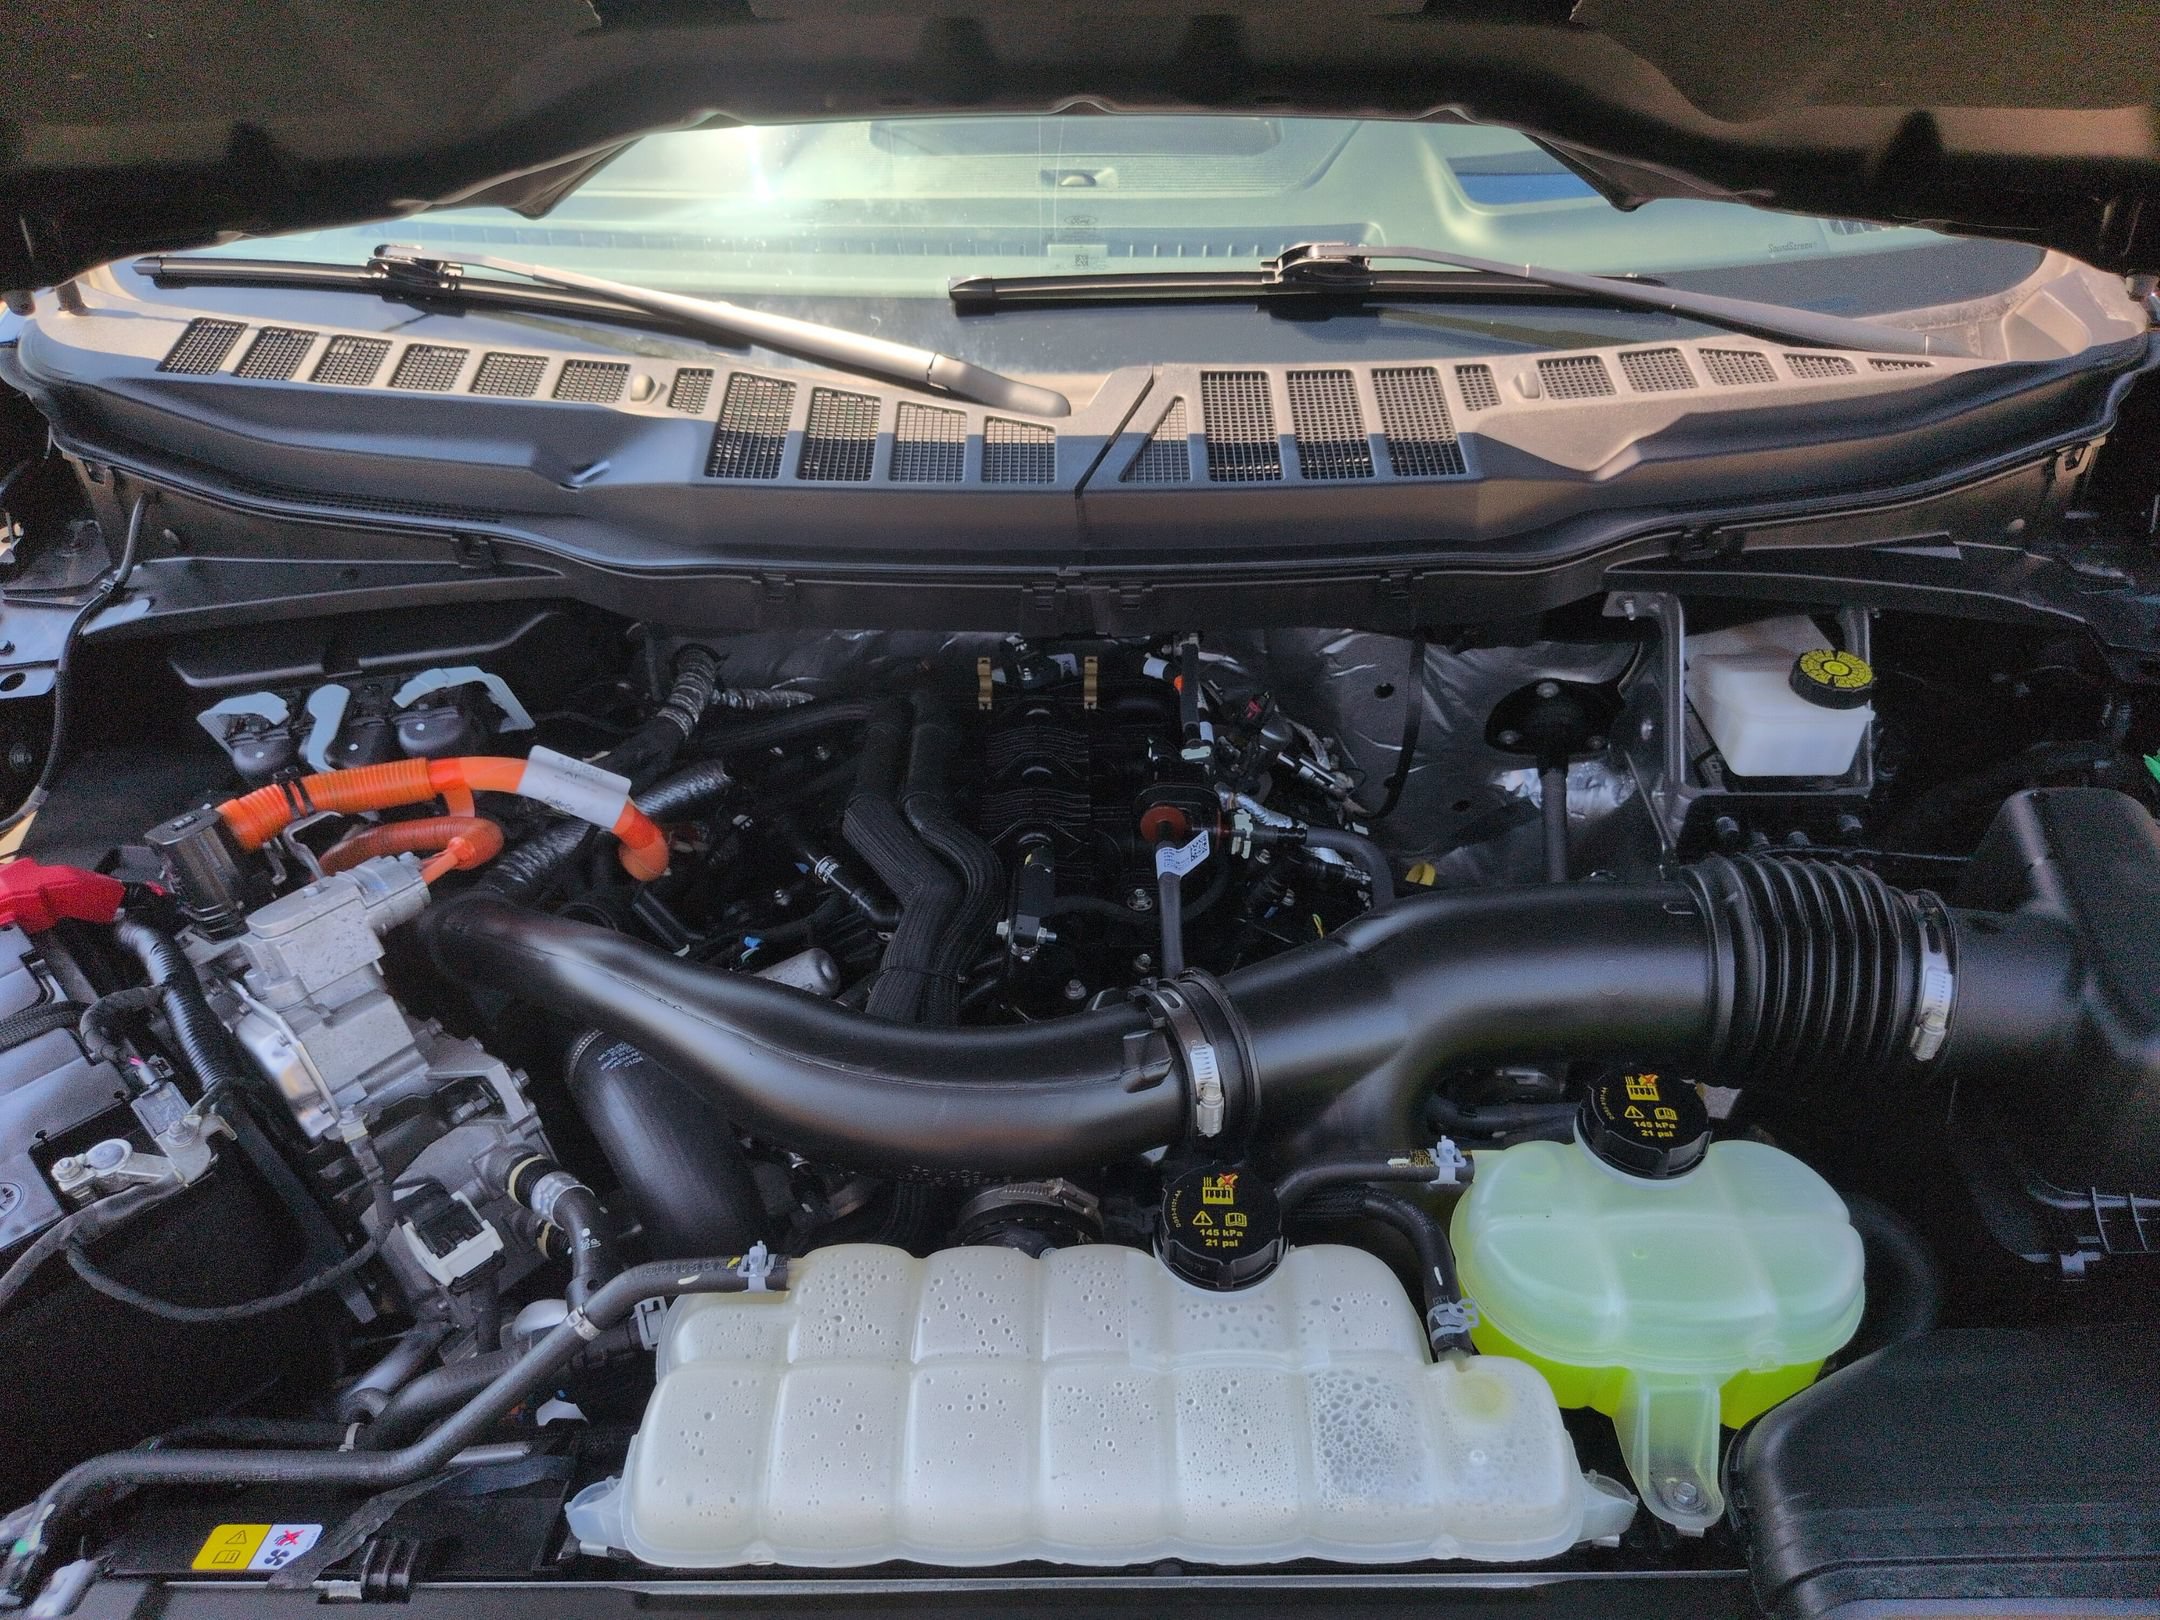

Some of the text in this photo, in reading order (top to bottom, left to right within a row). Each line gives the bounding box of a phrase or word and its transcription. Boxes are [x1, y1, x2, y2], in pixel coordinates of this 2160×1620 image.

[1656, 1121, 1676, 1129] kPa
[1200, 1229, 1243, 1237] 145 kPa
[1205, 1239, 1238, 1248] 21 psi
